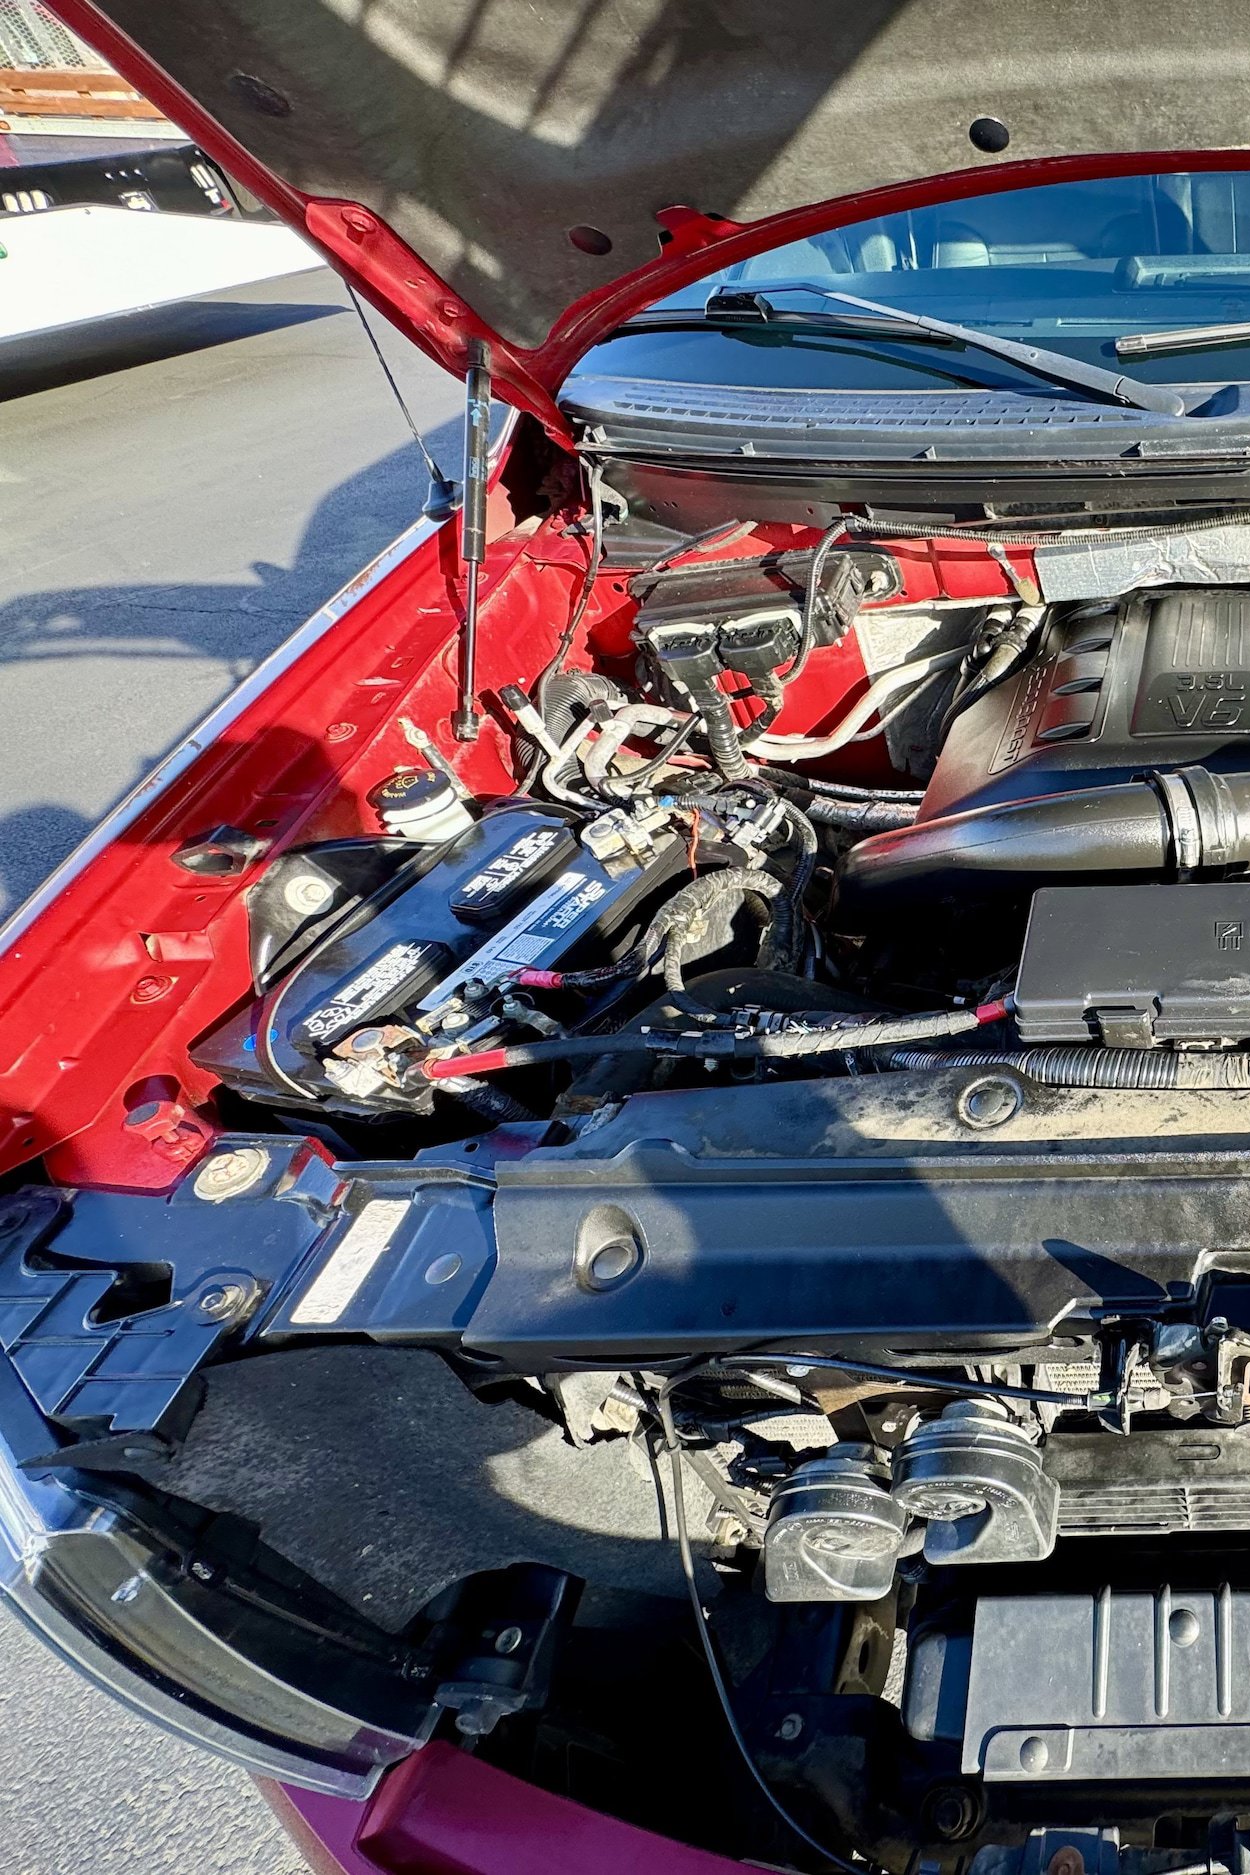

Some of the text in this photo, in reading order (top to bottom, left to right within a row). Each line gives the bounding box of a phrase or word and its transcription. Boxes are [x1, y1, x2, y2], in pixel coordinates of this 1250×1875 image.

[1176, 673, 1245, 691] 3.5L
[1167, 693, 1246, 728] V6
[549, 879, 601, 927] START
[557, 887, 606, 929] SUPER
